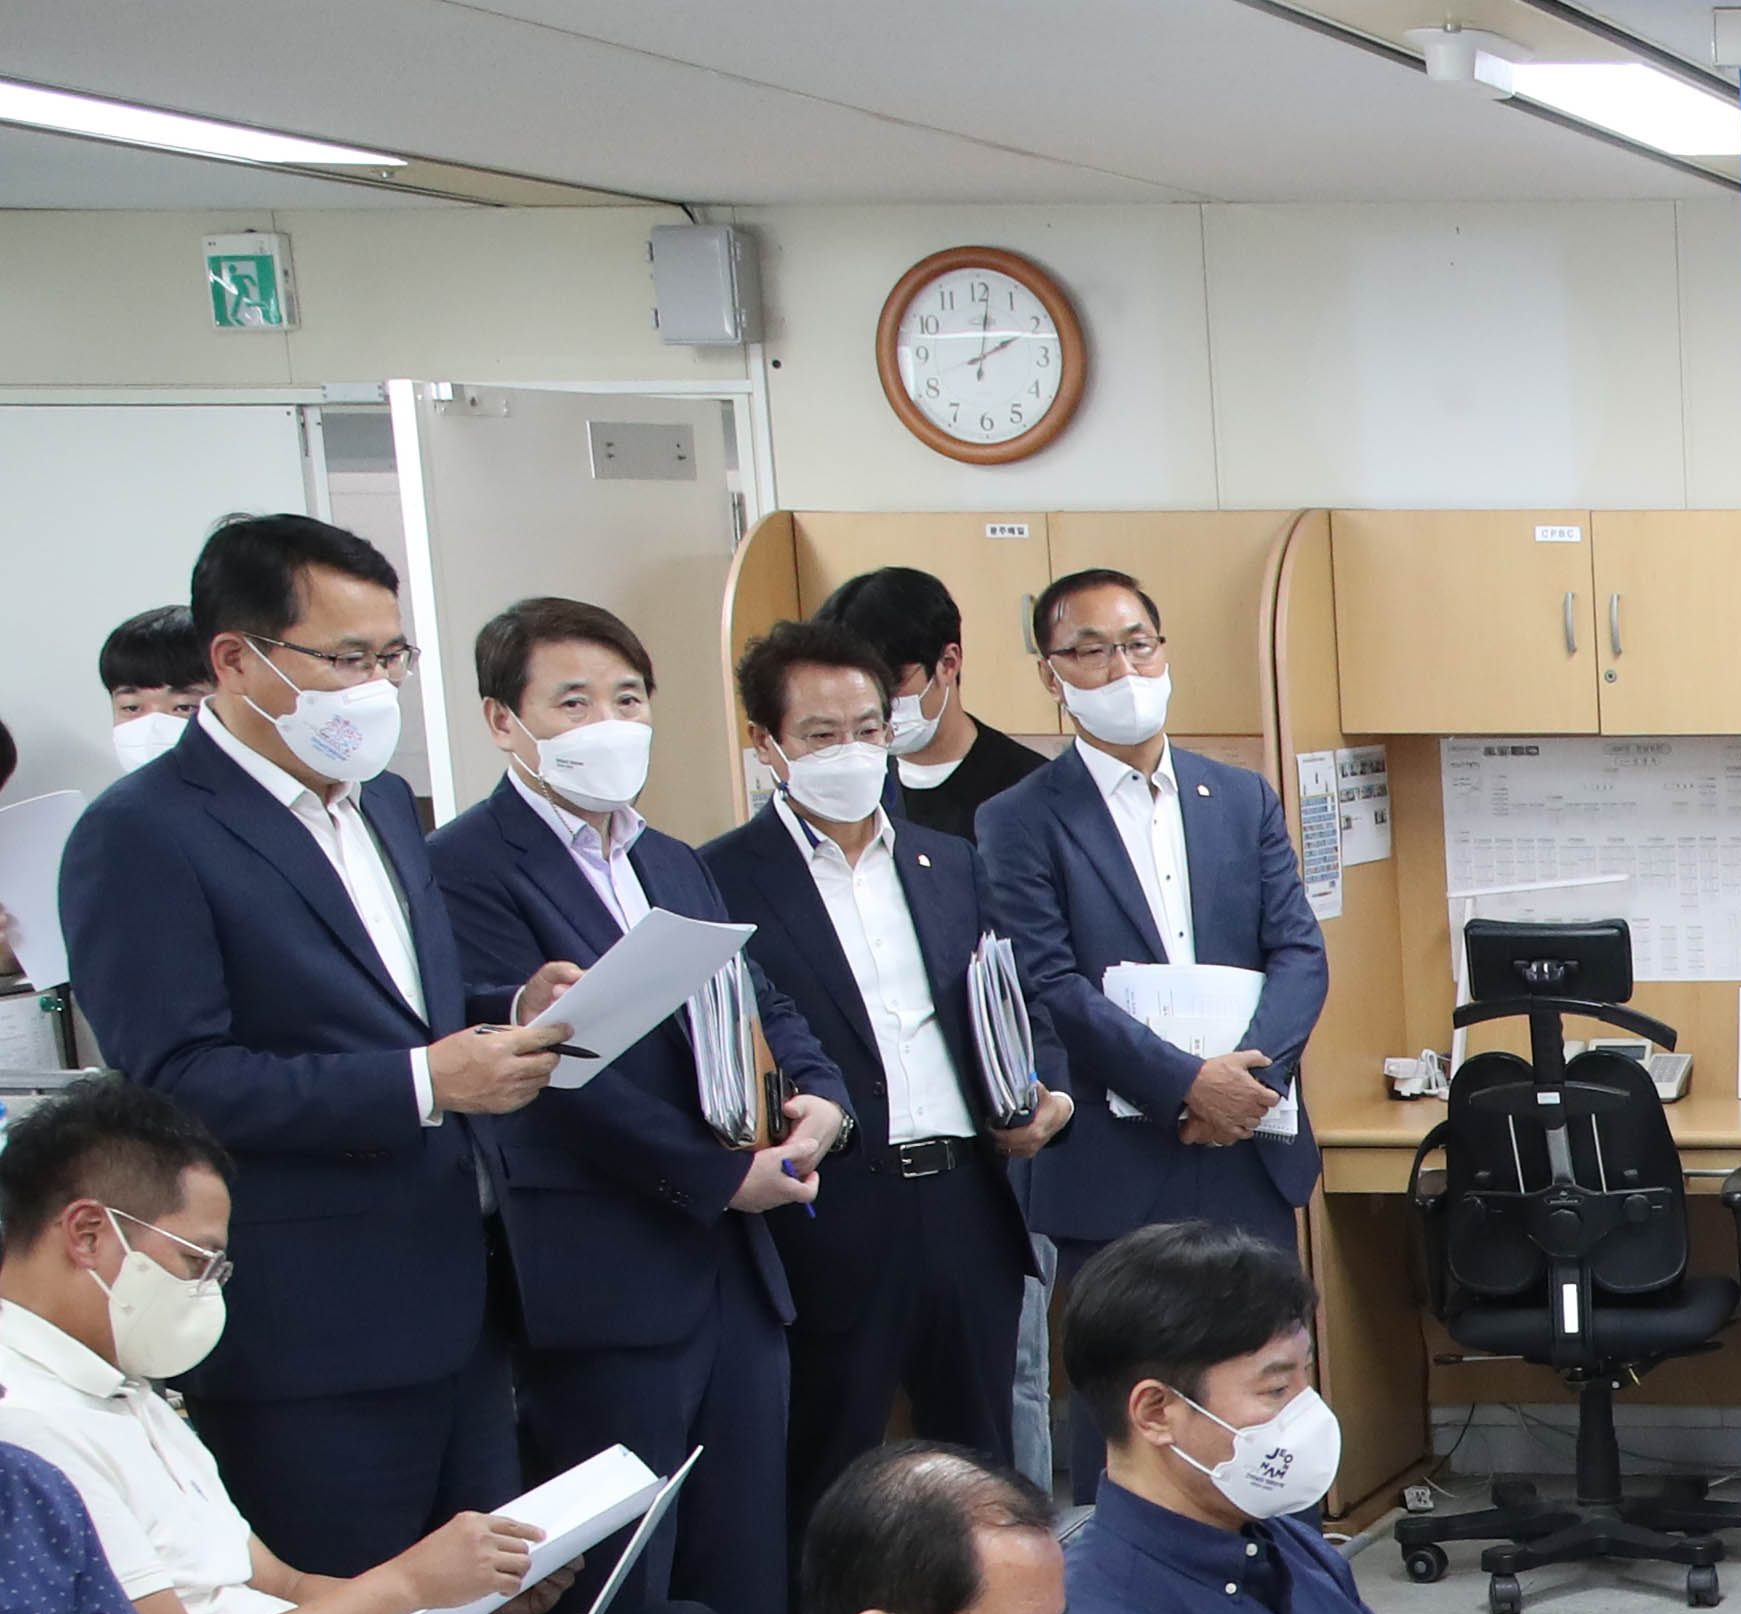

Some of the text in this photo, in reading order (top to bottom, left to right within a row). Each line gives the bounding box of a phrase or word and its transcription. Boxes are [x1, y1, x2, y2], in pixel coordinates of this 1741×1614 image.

[939, 290, 955, 311] 11
[970, 281, 990, 303] 12
[1008, 290, 1015, 312] 1
[919, 314, 940, 335] 10
[1029, 315, 1042, 334] 2
[915, 345, 930, 364] 9
[1036, 346, 1050, 368] 3
[925, 377, 941, 400] 8
[1027, 378, 1041, 399] 4
[949, 401, 961, 424] 7
[979, 413, 995, 432] 6
[1009, 403, 1024, 424] 5
